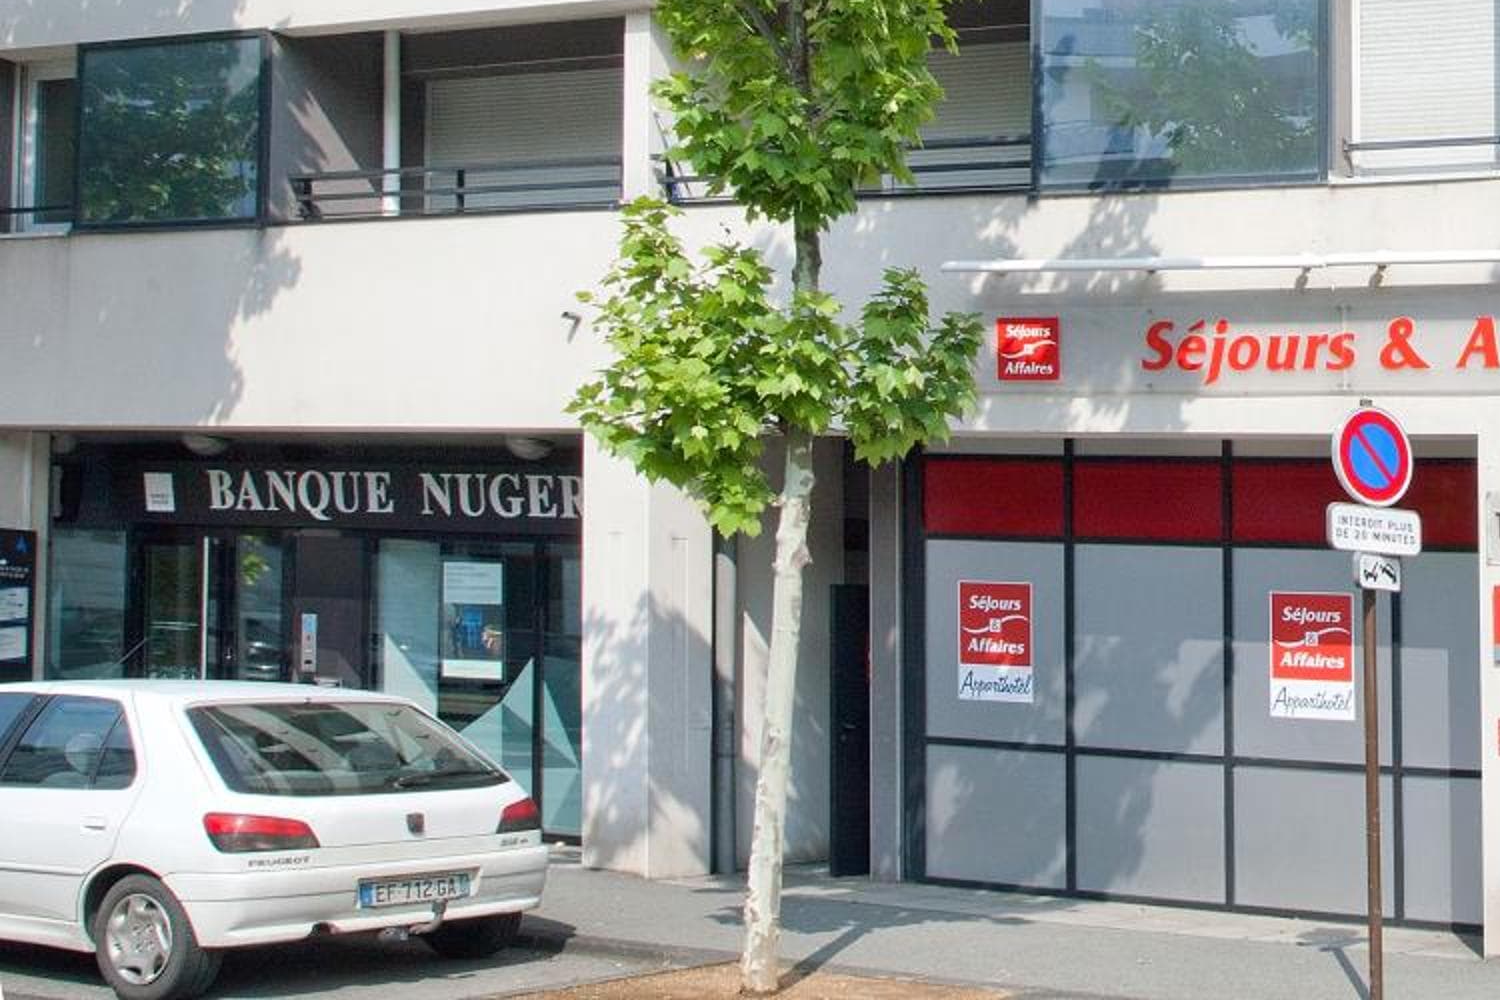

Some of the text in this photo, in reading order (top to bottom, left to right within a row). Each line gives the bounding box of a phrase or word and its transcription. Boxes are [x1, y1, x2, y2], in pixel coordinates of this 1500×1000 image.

[1141, 318, 1356, 385] Séjours
[1379, 317, 1431, 370] &
[1005, 361, 1054, 375] Affaires
[207, 469, 395, 521] BANQUE
[1387, 519, 1414, 533] PLUS
[1281, 605, 1341, 625] Séjours
[967, 636, 1025, 655] Affaires
[1279, 650, 1345, 669] Affaires
